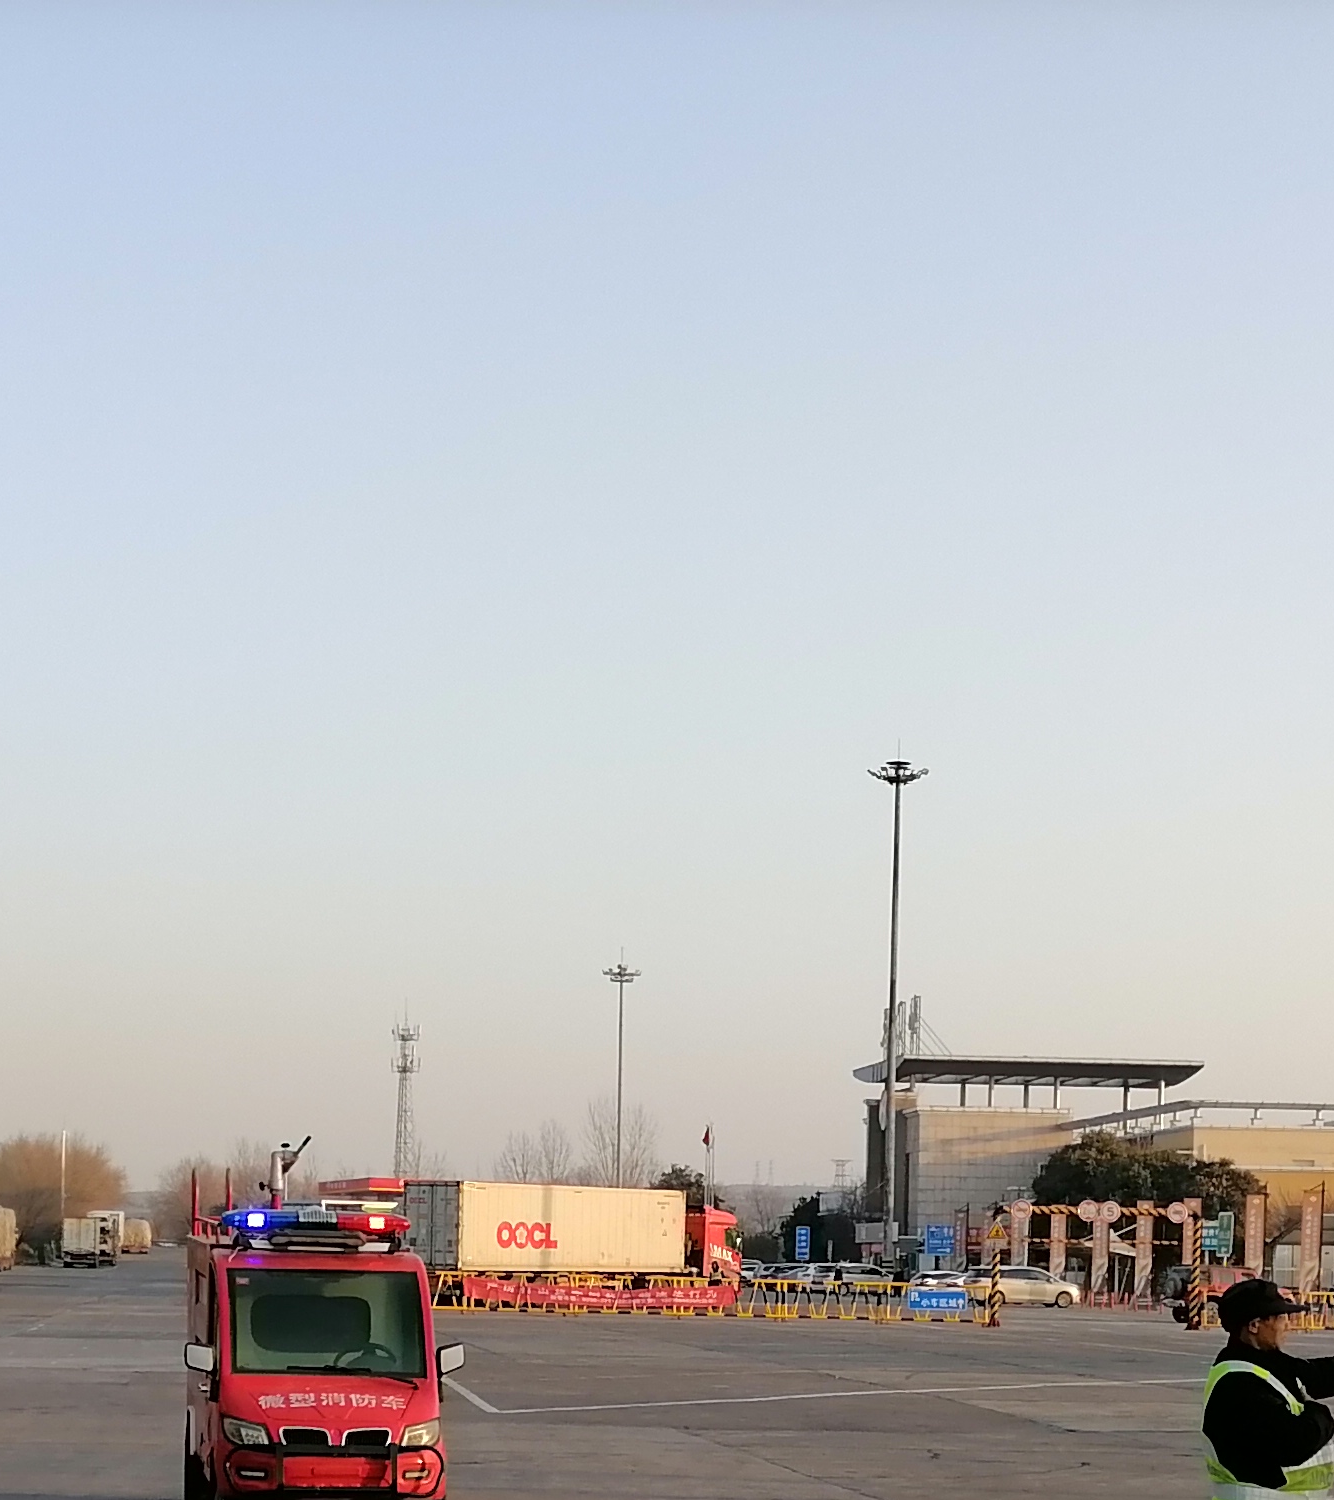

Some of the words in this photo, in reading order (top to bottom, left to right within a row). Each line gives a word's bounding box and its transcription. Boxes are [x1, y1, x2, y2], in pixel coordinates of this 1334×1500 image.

[1106, 1206, 1115, 1217] 5
[496, 1221, 558, 1249] OOCL
[258, 1392, 407, 1410] 微型消防车
